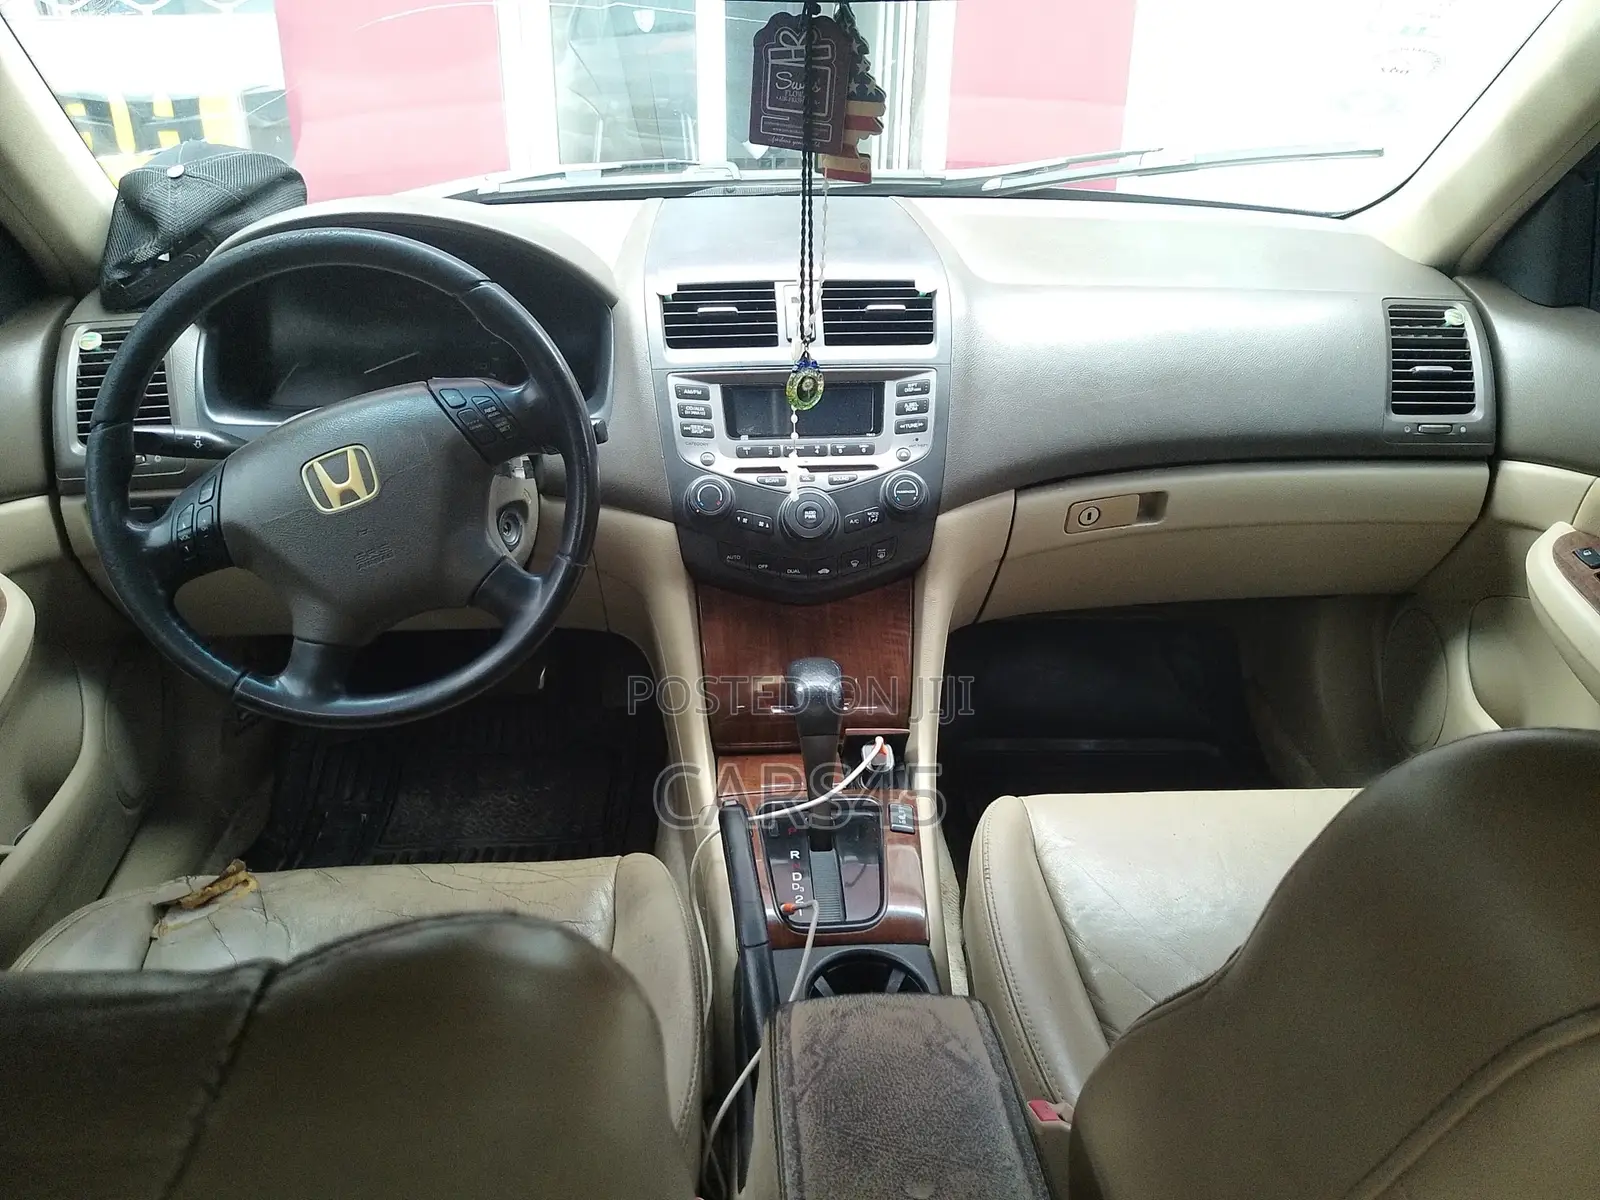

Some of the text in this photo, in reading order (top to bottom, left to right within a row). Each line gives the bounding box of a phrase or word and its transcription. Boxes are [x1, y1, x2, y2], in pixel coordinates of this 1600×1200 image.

[790, 850, 800, 860] R
[792, 872, 802, 881] D
[795, 895, 804, 903] 2
